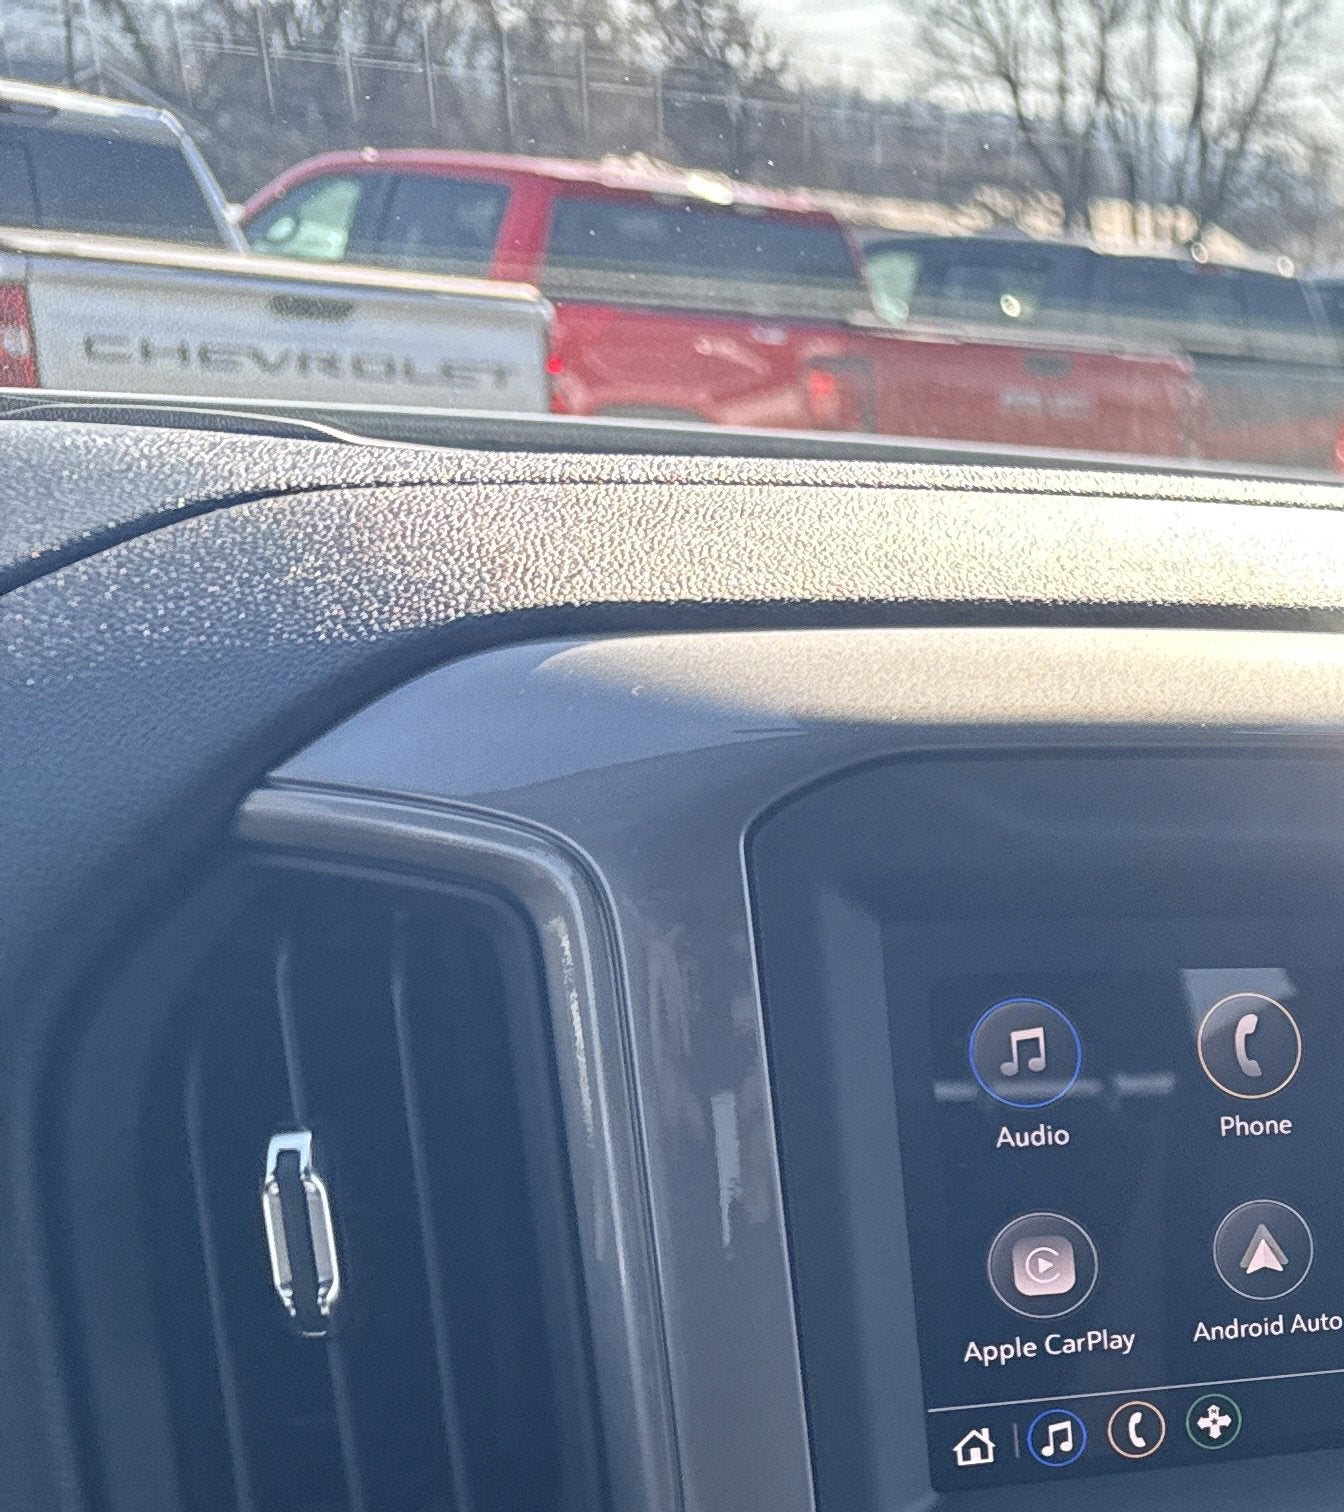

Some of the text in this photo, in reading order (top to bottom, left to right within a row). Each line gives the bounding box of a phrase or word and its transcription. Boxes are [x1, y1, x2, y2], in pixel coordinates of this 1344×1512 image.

[83, 333, 516, 388] CHEVROLET
[996, 1124, 1070, 1148] Audio
[1220, 1115, 1293, 1137] Phone
[1193, 1313, 1343, 1342] Android Auto
[963, 1328, 1136, 1367] Apple CarPlay
